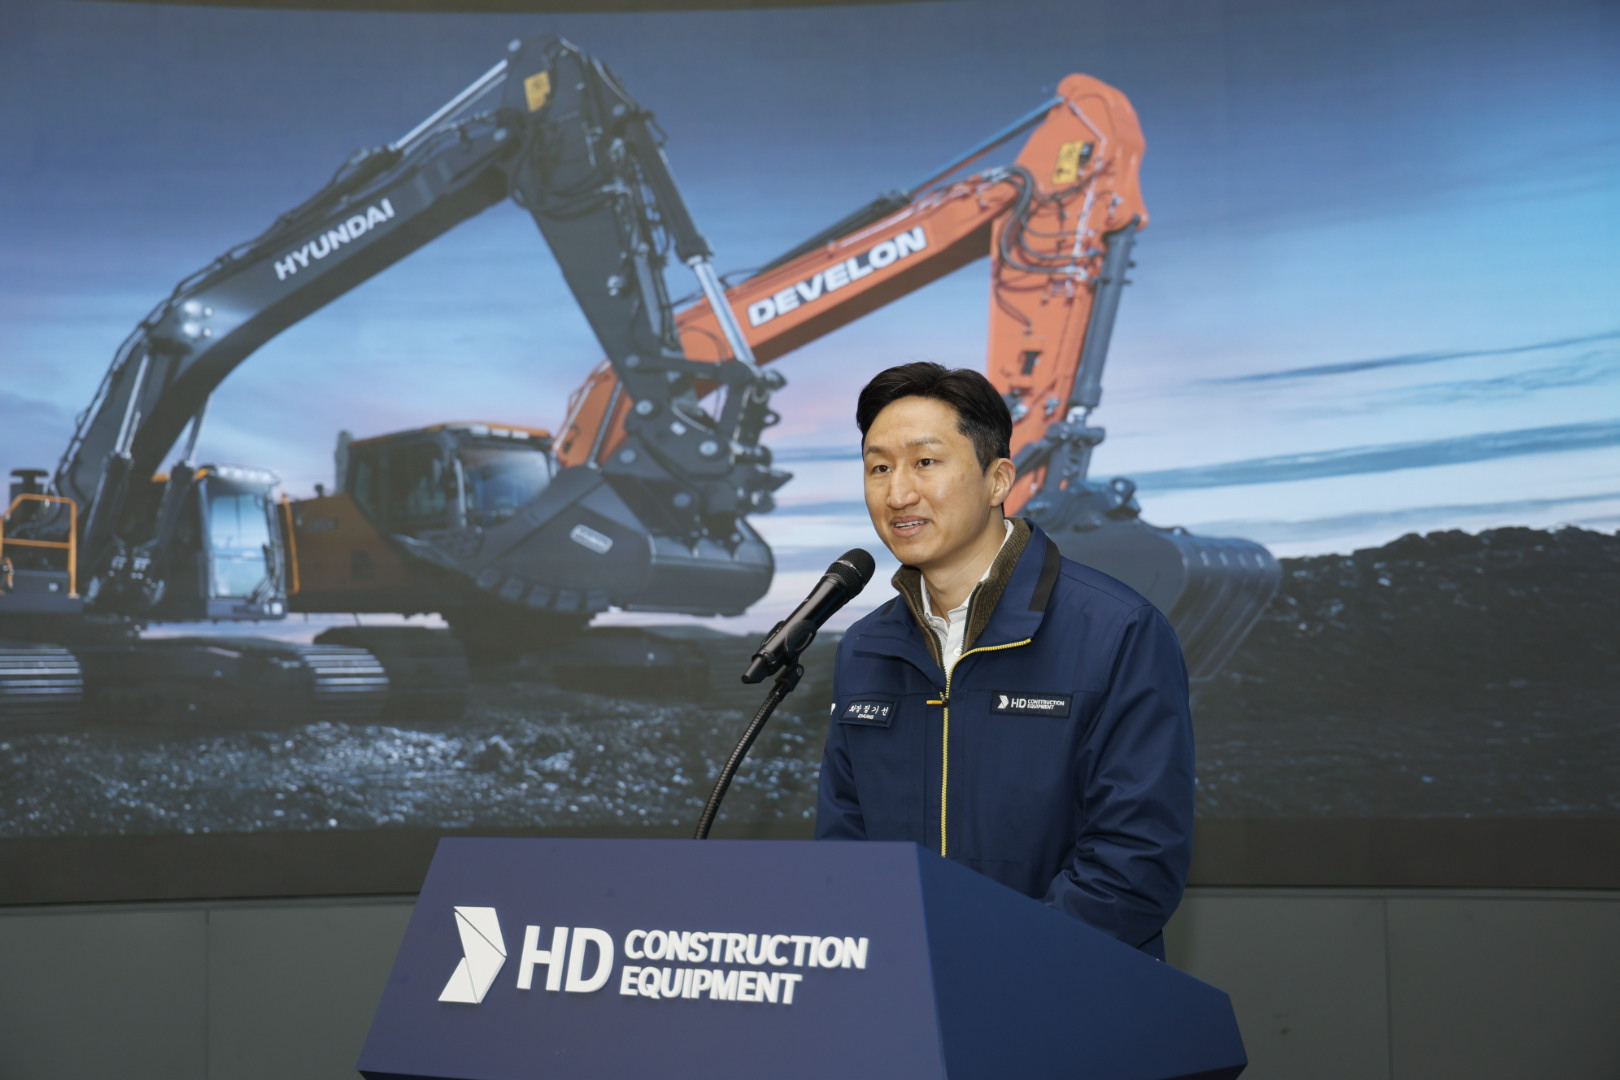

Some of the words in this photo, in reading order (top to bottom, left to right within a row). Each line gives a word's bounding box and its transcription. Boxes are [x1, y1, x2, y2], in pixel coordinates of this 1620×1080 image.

[274, 197, 395, 280] HYUNDAI
[747, 225, 927, 328] DEVELON
[1010, 698, 1027, 708] HD
[516, 925, 614, 993] HD
[624, 929, 869, 969] CONSTRUCTION
[619, 966, 803, 1005] EQUIPMENT
